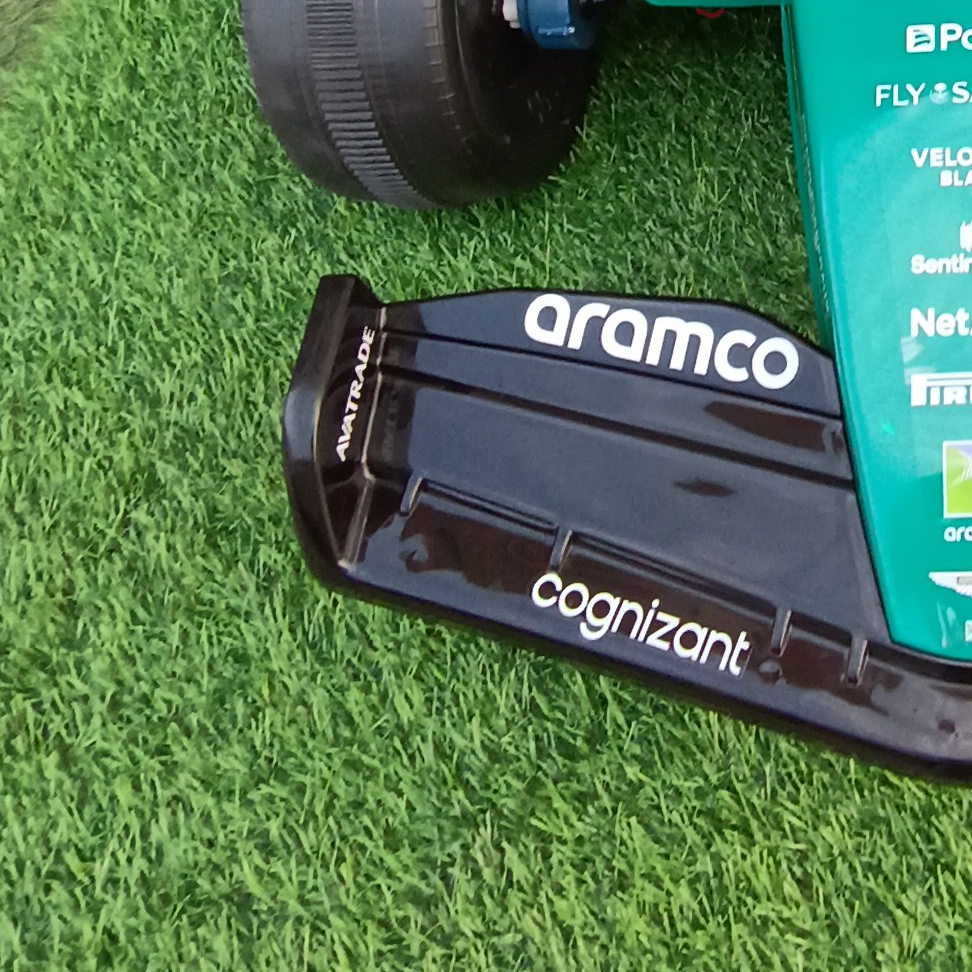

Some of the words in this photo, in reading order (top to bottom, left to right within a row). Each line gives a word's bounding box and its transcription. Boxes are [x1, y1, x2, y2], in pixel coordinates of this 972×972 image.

[875, 82, 926, 107] FLY
[523, 293, 800, 390] aramco
[336, 325, 375, 463] AVATRADE
[530, 573, 752, 677] cognizant
